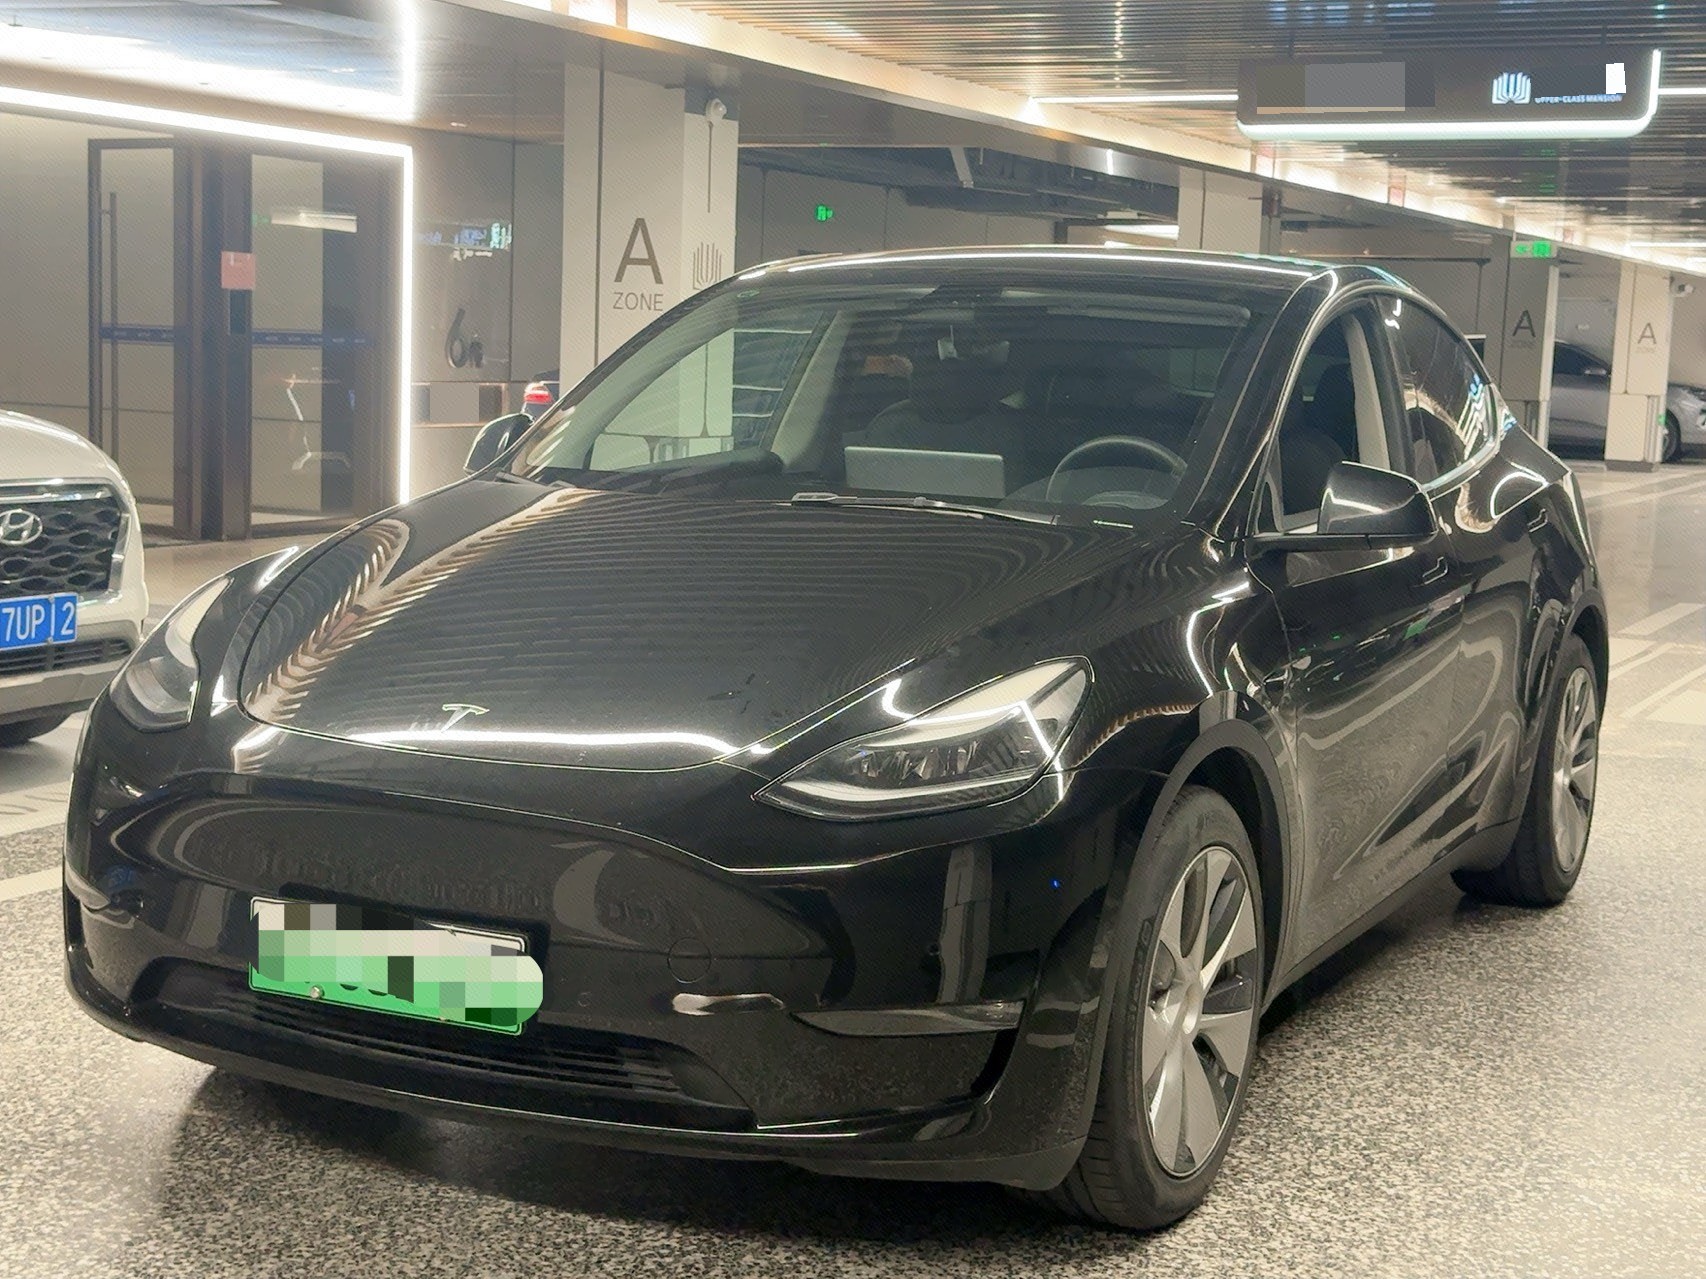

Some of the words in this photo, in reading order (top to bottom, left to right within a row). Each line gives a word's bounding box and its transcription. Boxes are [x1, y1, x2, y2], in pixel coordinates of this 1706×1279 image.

[613, 217, 664, 285] A
[612, 291, 664, 312] ZONE
[1512, 309, 1536, 338] A
[1637, 322, 1657, 345] A
